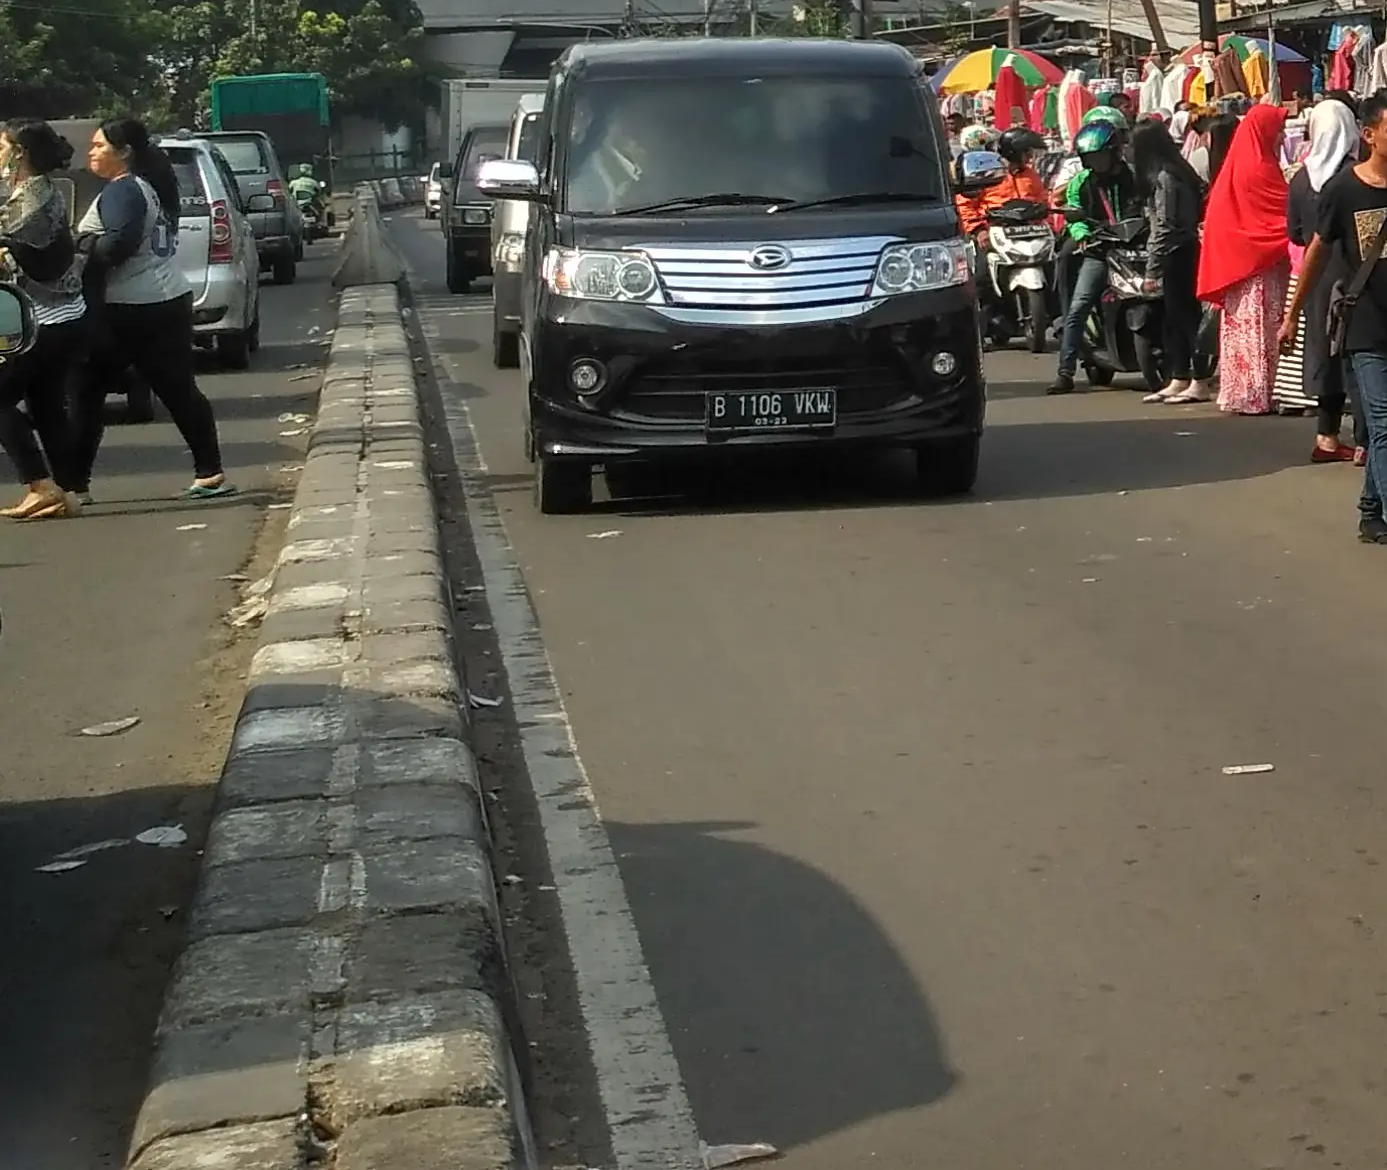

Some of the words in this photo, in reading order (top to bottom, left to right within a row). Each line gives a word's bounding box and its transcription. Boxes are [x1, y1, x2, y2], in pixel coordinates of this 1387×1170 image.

[714, 397, 726, 417] B
[739, 394, 782, 417] 1106
[794, 392, 830, 414] VKW
